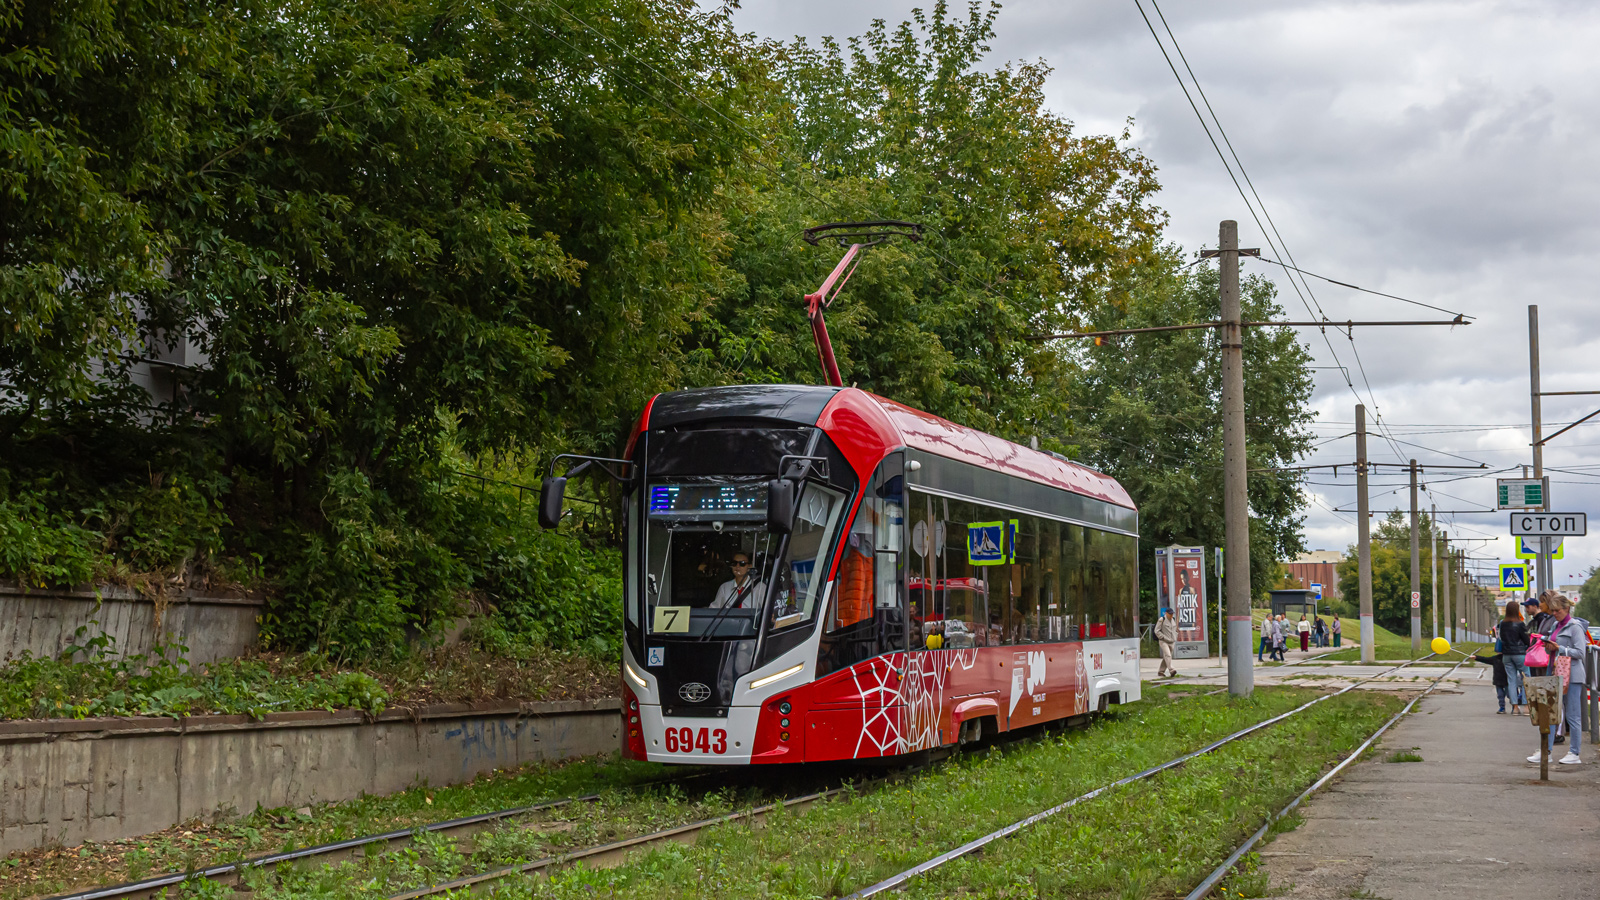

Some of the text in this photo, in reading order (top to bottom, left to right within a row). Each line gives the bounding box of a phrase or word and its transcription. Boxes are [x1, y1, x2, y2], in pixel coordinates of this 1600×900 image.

[1521, 517, 1576, 531] СТОП
[1177, 594, 1199, 608] ARTIK
[663, 609, 680, 631] 7
[1179, 608, 1196, 623] ASTI
[665, 726, 727, 755] 6943
